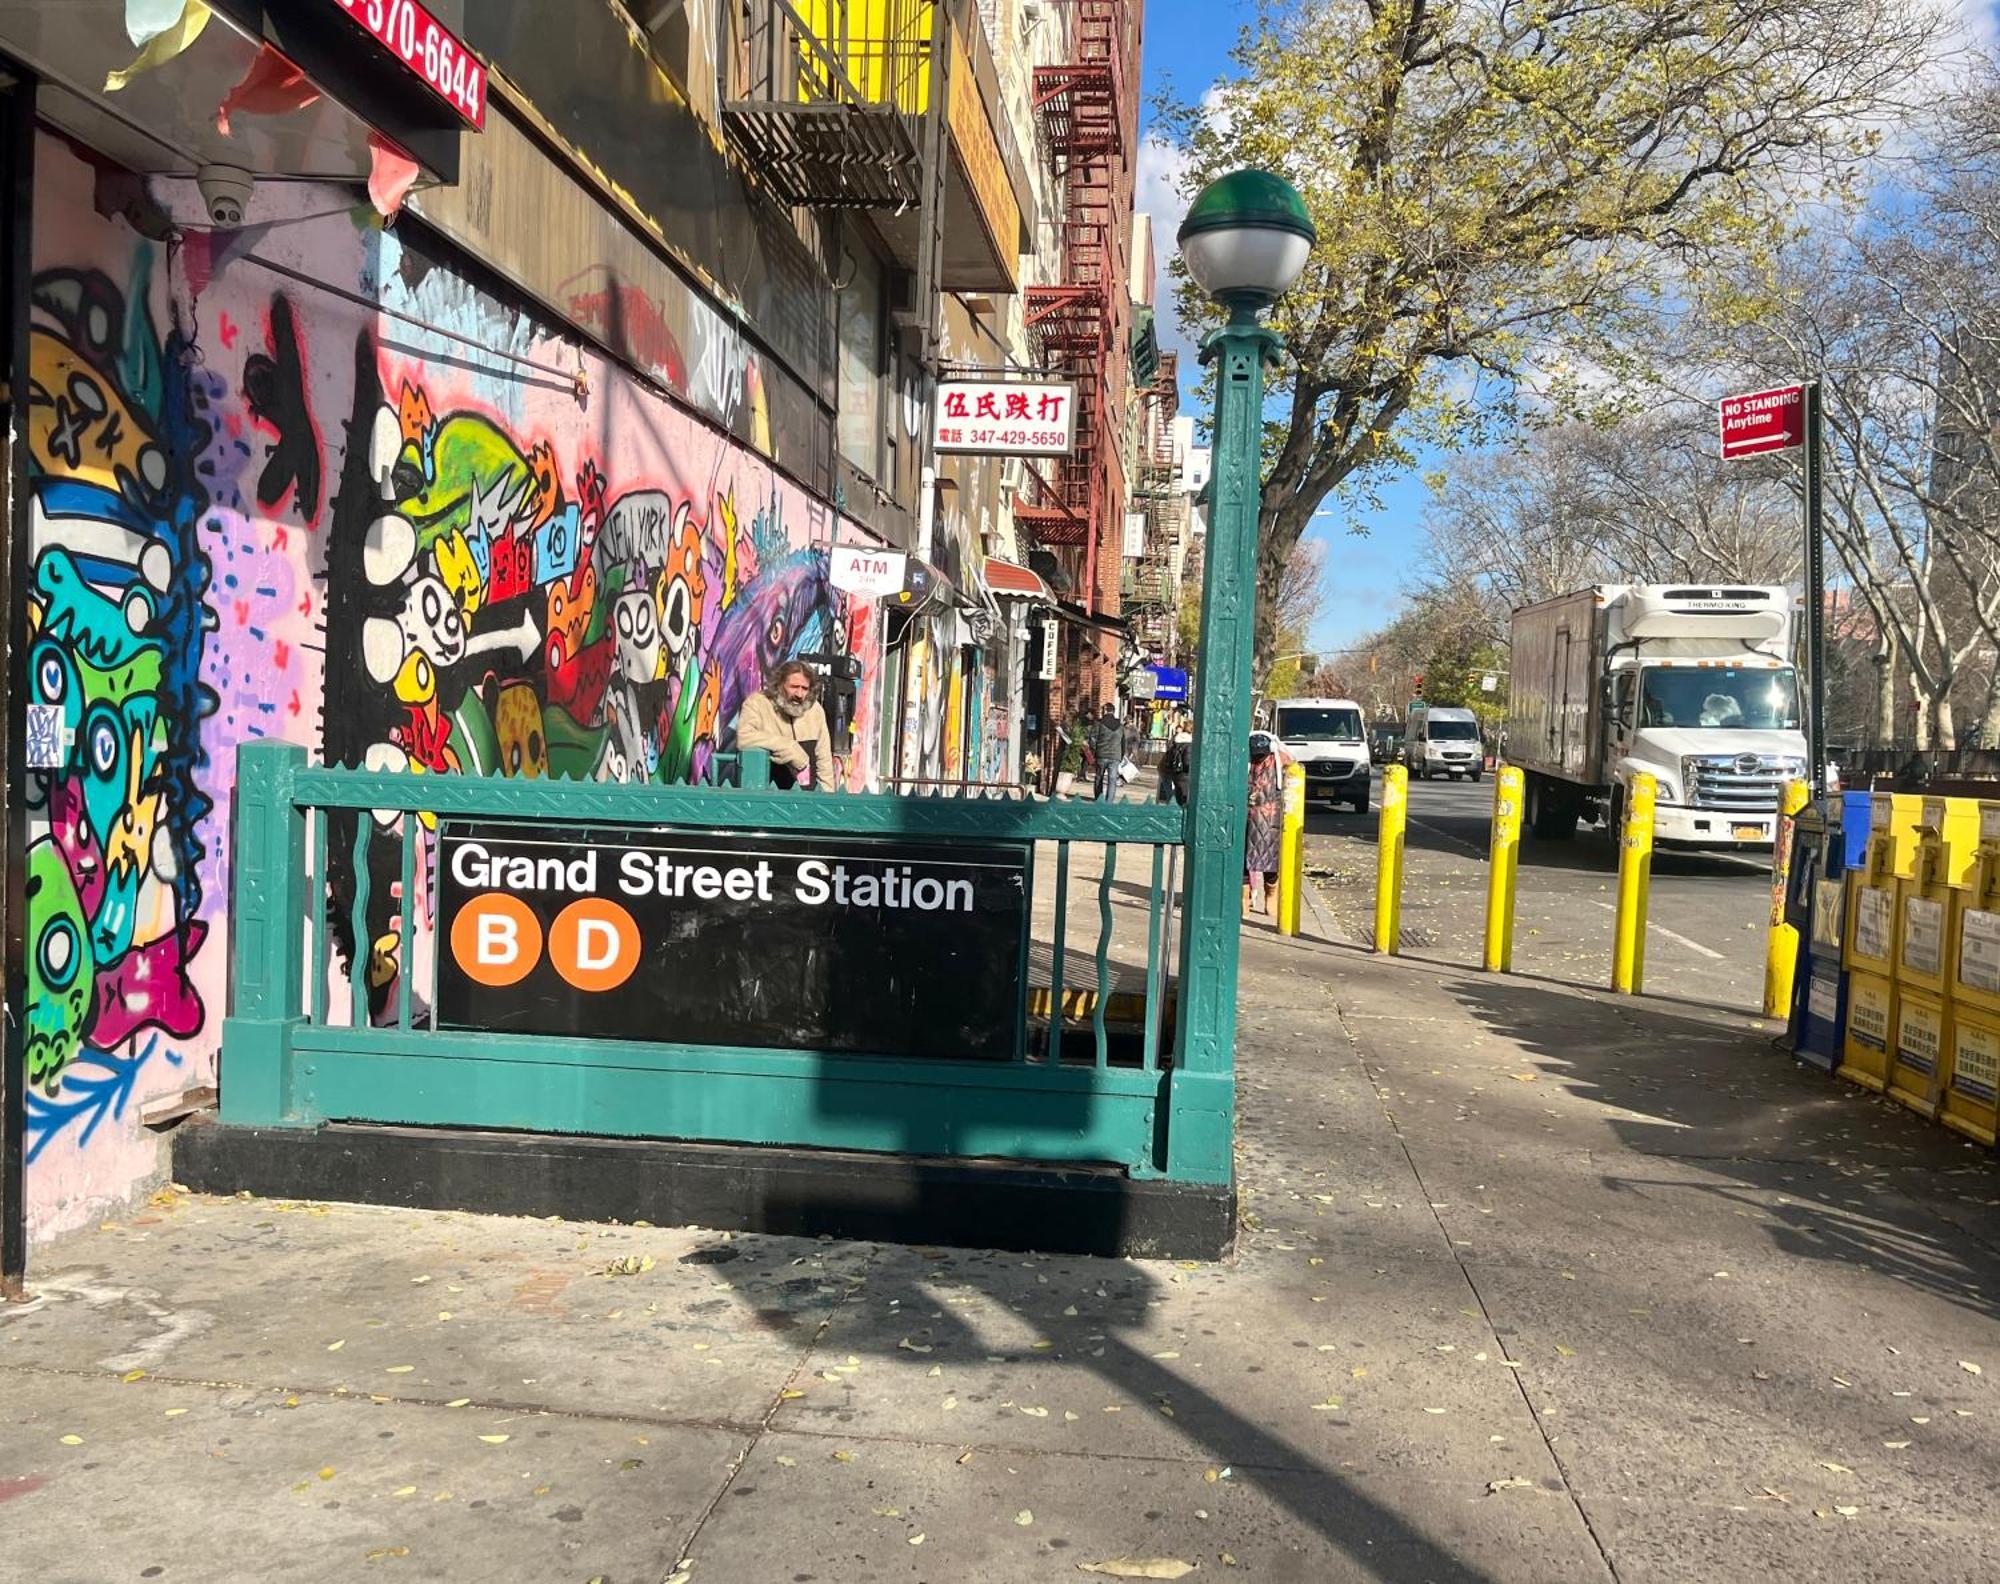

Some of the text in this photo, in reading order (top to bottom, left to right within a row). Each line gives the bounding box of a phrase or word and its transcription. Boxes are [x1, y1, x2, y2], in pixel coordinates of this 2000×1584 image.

[944, 391, 1065, 422] 伍氏跌打
[1725, 392, 1799, 416] NO STANDING
[938, 428, 1065, 445] 電話 347-429-5650
[1726, 413, 1773, 430] Anytime
[598, 506, 666, 575] NEW YORK
[850, 558, 888, 575] ATM
[1046, 621, 1056, 676] COFFEE
[451, 843, 975, 912] Grand Street Station
[477, 913, 621, 970] B D
